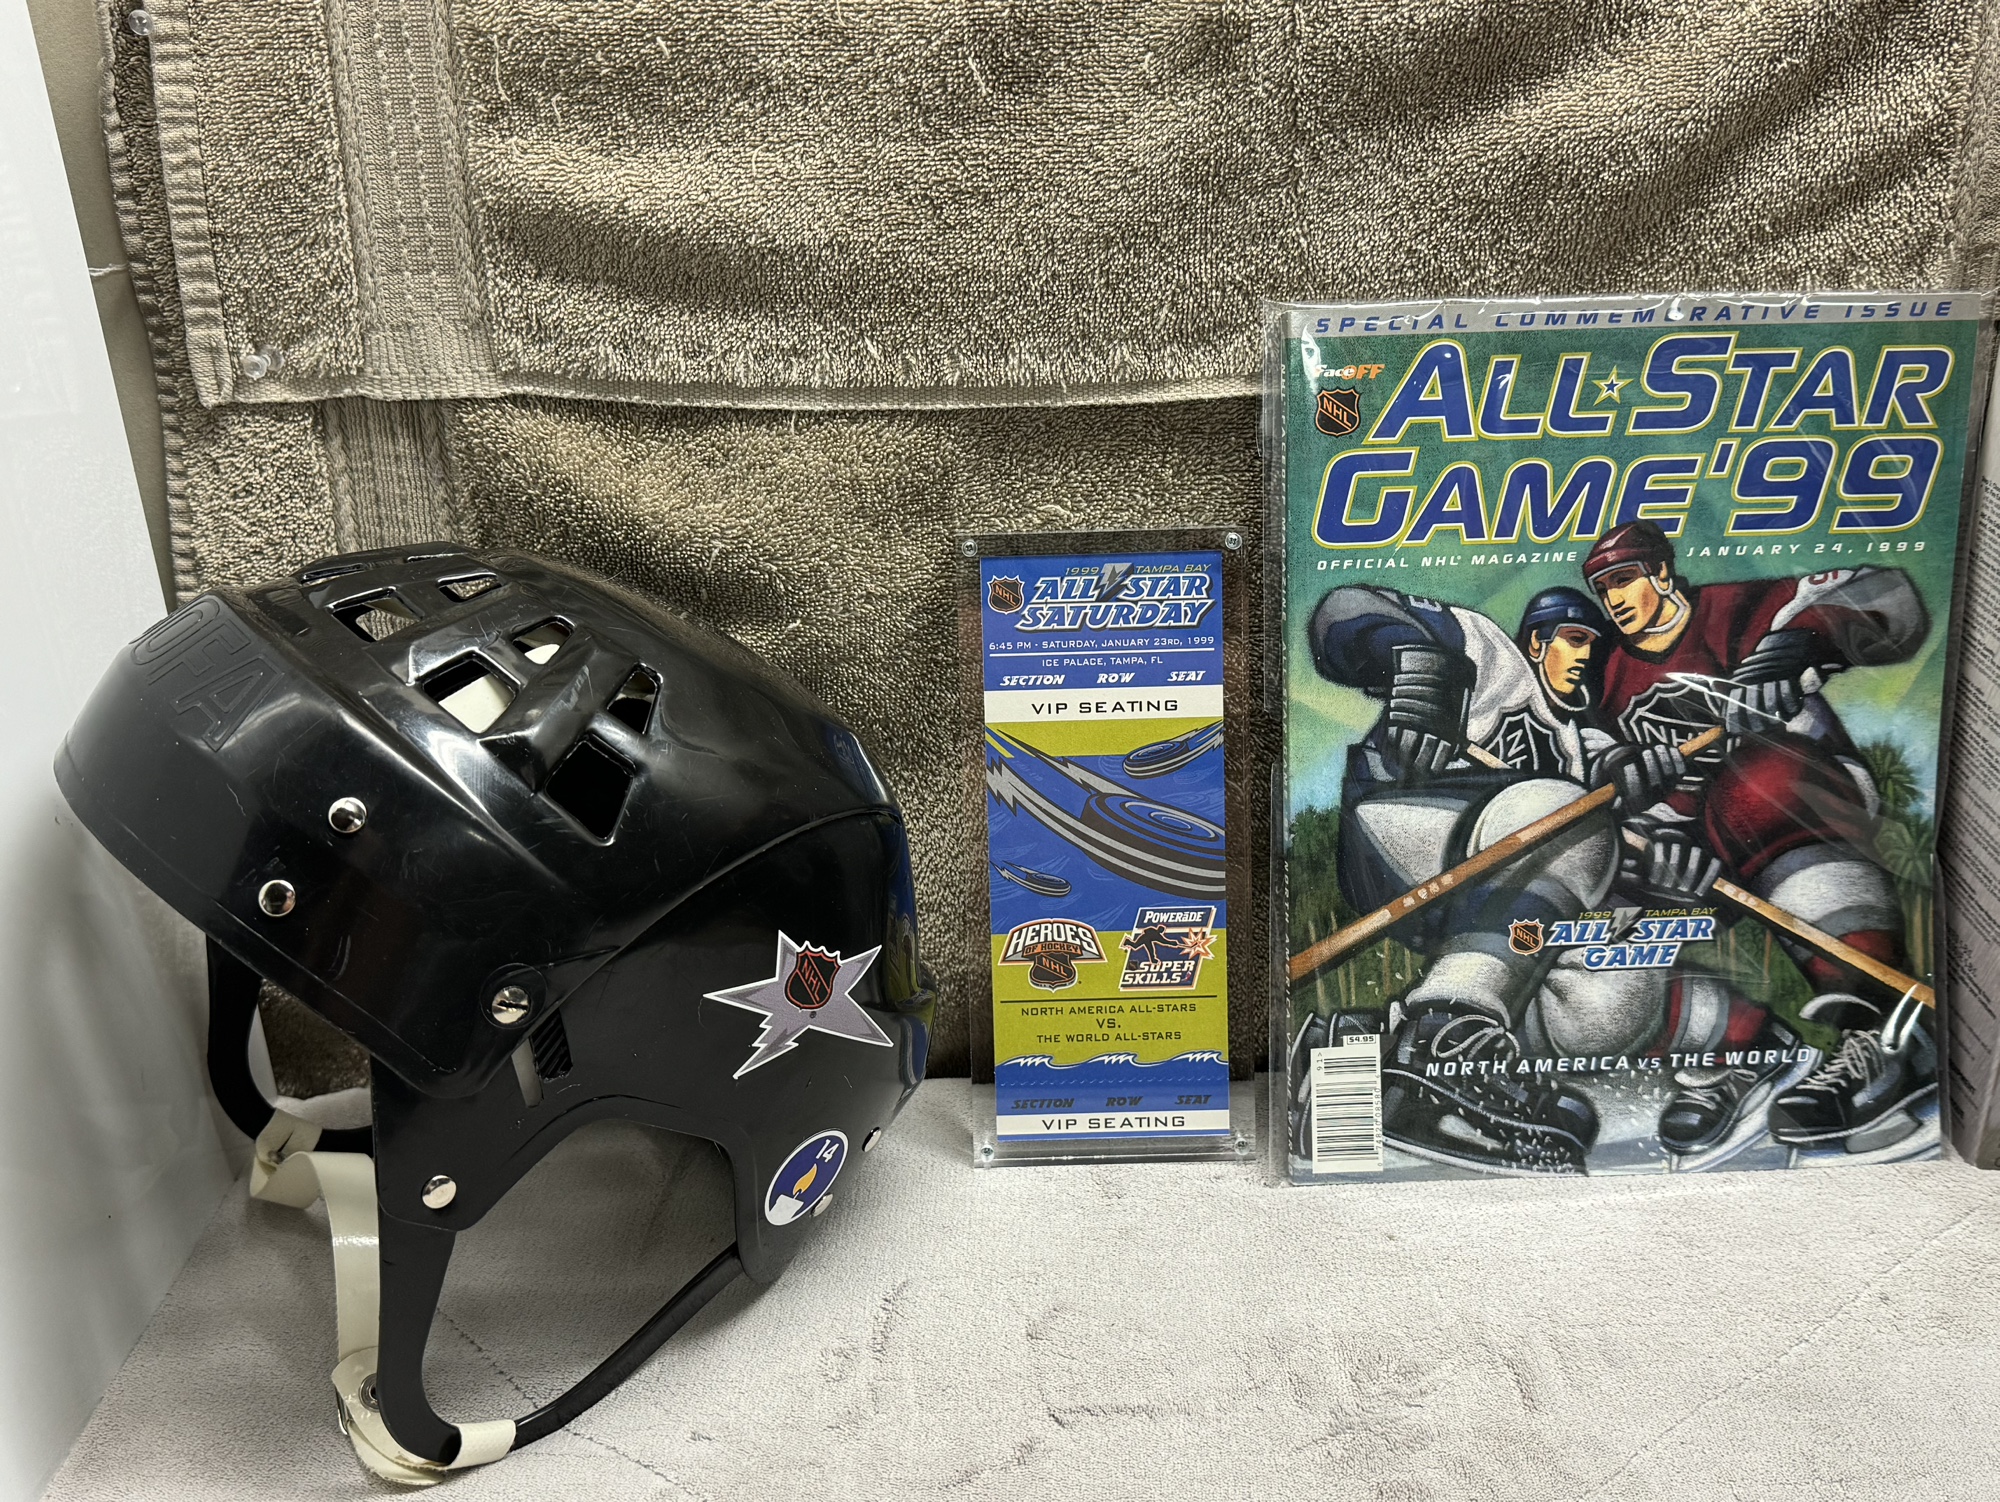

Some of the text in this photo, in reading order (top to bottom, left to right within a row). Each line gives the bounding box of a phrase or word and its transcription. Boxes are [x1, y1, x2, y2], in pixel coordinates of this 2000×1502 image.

[1315, 313, 1469, 334] SPECIAL
[1845, 301, 1953, 319] ISSUE
[1362, 331, 1956, 444] ALL STAR
[1323, 397, 1352, 428] NHL
[1687, 541, 1927, 557] JANUARY 24, 1999
[1065, 564, 1212, 576] 1999 TAMPA BAY
[1317, 556, 1409, 571] OFFICIAL
[1471, 551, 1579, 565] MAGAZINE
[994, 584, 1017, 606] NHL
[1033, 573, 1211, 602] ALL STAR
[1015, 600, 1215, 631] SATURDAY
[989, 641, 1013, 650] 6:45
[1017, 641, 1031, 650] PM
[1042, 639, 1098, 650] SATURDAY,
[1101, 638, 1150, 648] JANUARY
[1153, 637, 1182, 648] 23RD,
[1187, 636, 1214, 645] 1999
[1042, 656, 1163, 668] ICE PALACE, TAMPA, FL
[999, 671, 1206, 686] SECTION ROW SEAT
[1031, 700, 1179, 715] VIP SEATING
[1578, 907, 1718, 920] 1999 TAMPA BAY
[1005, 923, 1100, 958] HEROES
[1516, 926, 1536, 948] NHL
[1546, 916, 1715, 946] ALL STAR
[1025, 942, 1080, 954] OF HOCKEY
[1583, 942, 1683, 971] GAME
[1042, 958, 1068, 977] NHL
[1139, 960, 1195, 972] SUPER
[802, 960, 821, 1003] NHL
[1122, 973, 1182, 985] SKILLS
[1021, 1003, 1197, 1016] NORTH AMERICA ALL-STARS
[1096, 1018, 1122, 1029] VS.
[1037, 1031, 1182, 1043] THE WORLD ALL-STARS
[1425, 1061, 1507, 1077] NORTH
[1516, 1056, 1630, 1074] AMERICA
[1670, 1053, 1715, 1067] THE
[1725, 1048, 1810, 1065] WORLD
[1011, 1094, 1212, 1109] SECTION ROW SEAT
[1374, 1088, 1382, 1118] 08580
[1042, 1116, 1186, 1131] VIP SEATING
[1375, 1121, 1383, 1150] 74820
[815, 1139, 839, 1163] 14
